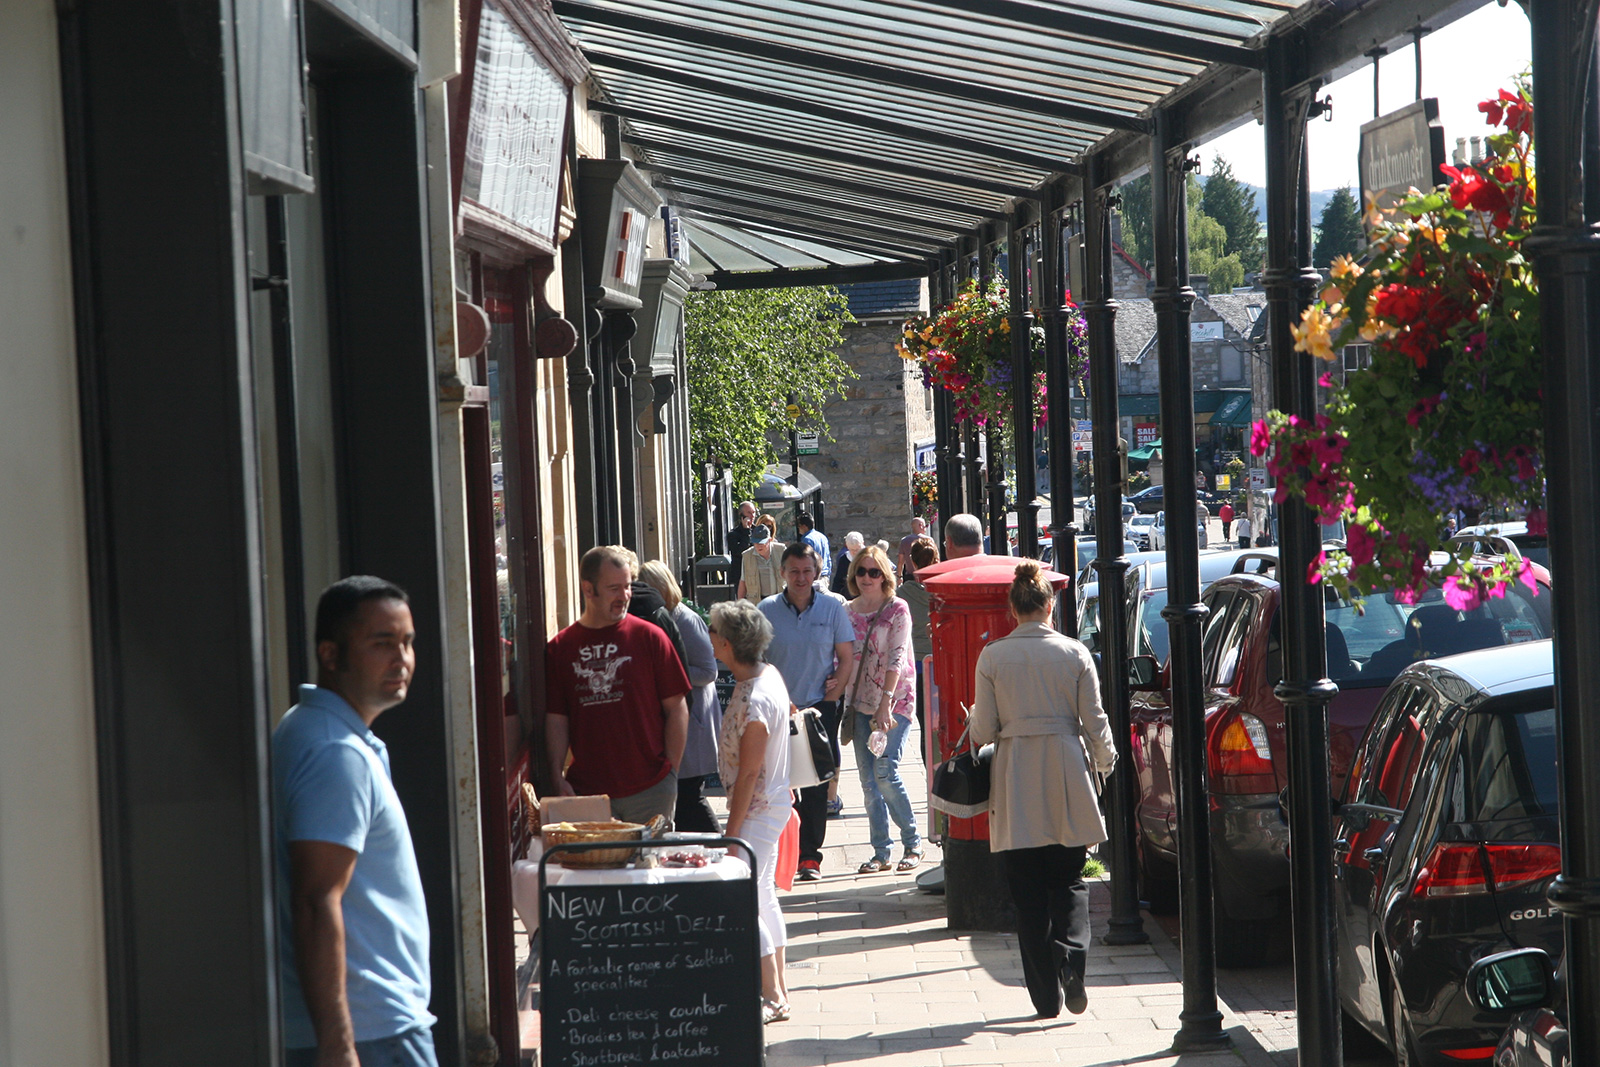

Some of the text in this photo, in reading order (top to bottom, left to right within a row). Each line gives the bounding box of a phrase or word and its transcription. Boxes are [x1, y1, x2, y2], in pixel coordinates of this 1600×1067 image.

[1368, 142, 1424, 191] drinkmonger
[1137, 427, 1156, 435] SALE
[578, 644, 618, 662] STP
[548, 889, 679, 919] NEW LOOK
[1510, 907, 1559, 920] GOLF
[571, 920, 665, 941] SCOTTISH
[550, 959, 561, 976] A
[628, 960, 661, 976] range
[665, 954, 681, 969] of
[685, 949, 734, 969] Scottish
[608, 1005, 659, 1021] cheese
[669, 993, 727, 1018] counter
[569, 1028, 622, 1045] Brodies
[628, 1028, 645, 1042] tea
[665, 1021, 708, 1039] coffee
[571, 1051, 643, 1067] Shortbread
[662, 1042, 720, 1060] oatcakes
